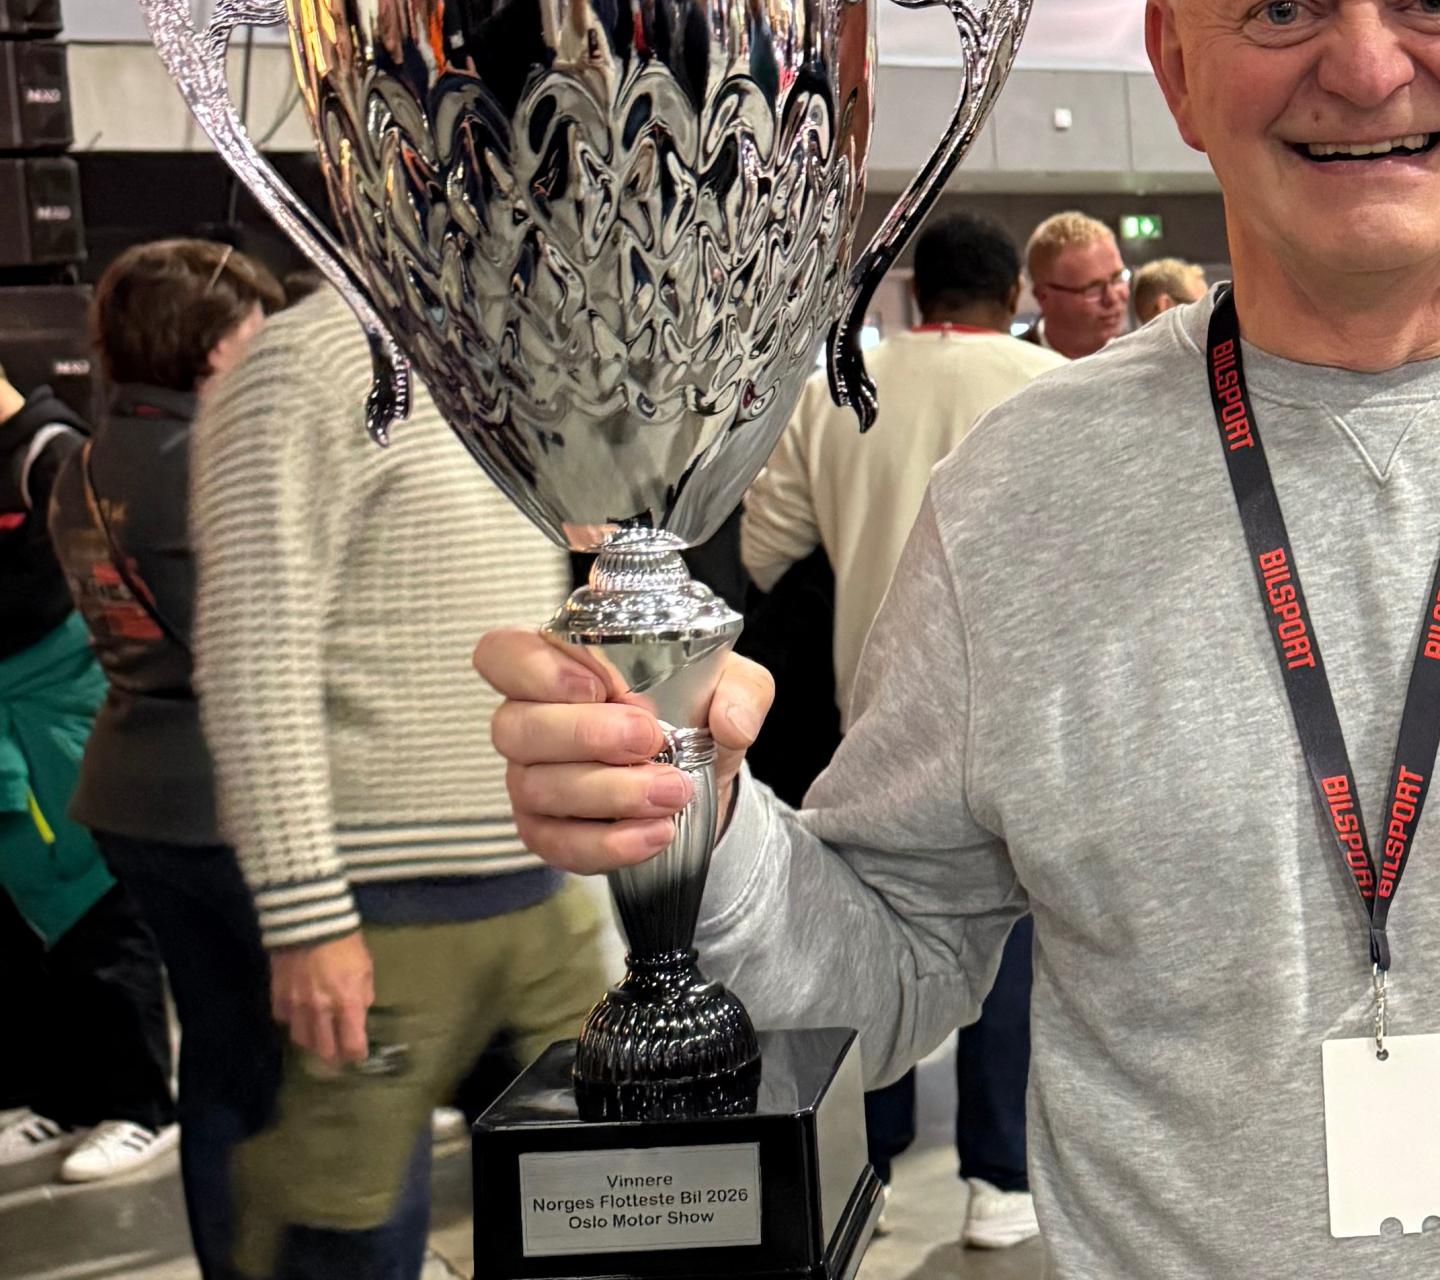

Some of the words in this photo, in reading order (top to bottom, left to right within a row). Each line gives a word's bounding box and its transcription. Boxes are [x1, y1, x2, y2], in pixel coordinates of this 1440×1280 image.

[1212, 338, 1255, 451] BILSPORT
[1259, 547, 1316, 669] BILSPORT
[1377, 764, 1423, 897] BILSPORT
[532, 1197, 595, 1214] Norges
[600, 1193, 675, 1209] Flotteste
[680, 1190, 702, 1205] Bil
[706, 1187, 748, 1203] 2026
[606, 1174, 673, 1189] Vinnere
[568, 1215, 608, 1230] Oslo
[612, 1212, 663, 1229] Motor
[667, 1210, 715, 1225] Show
